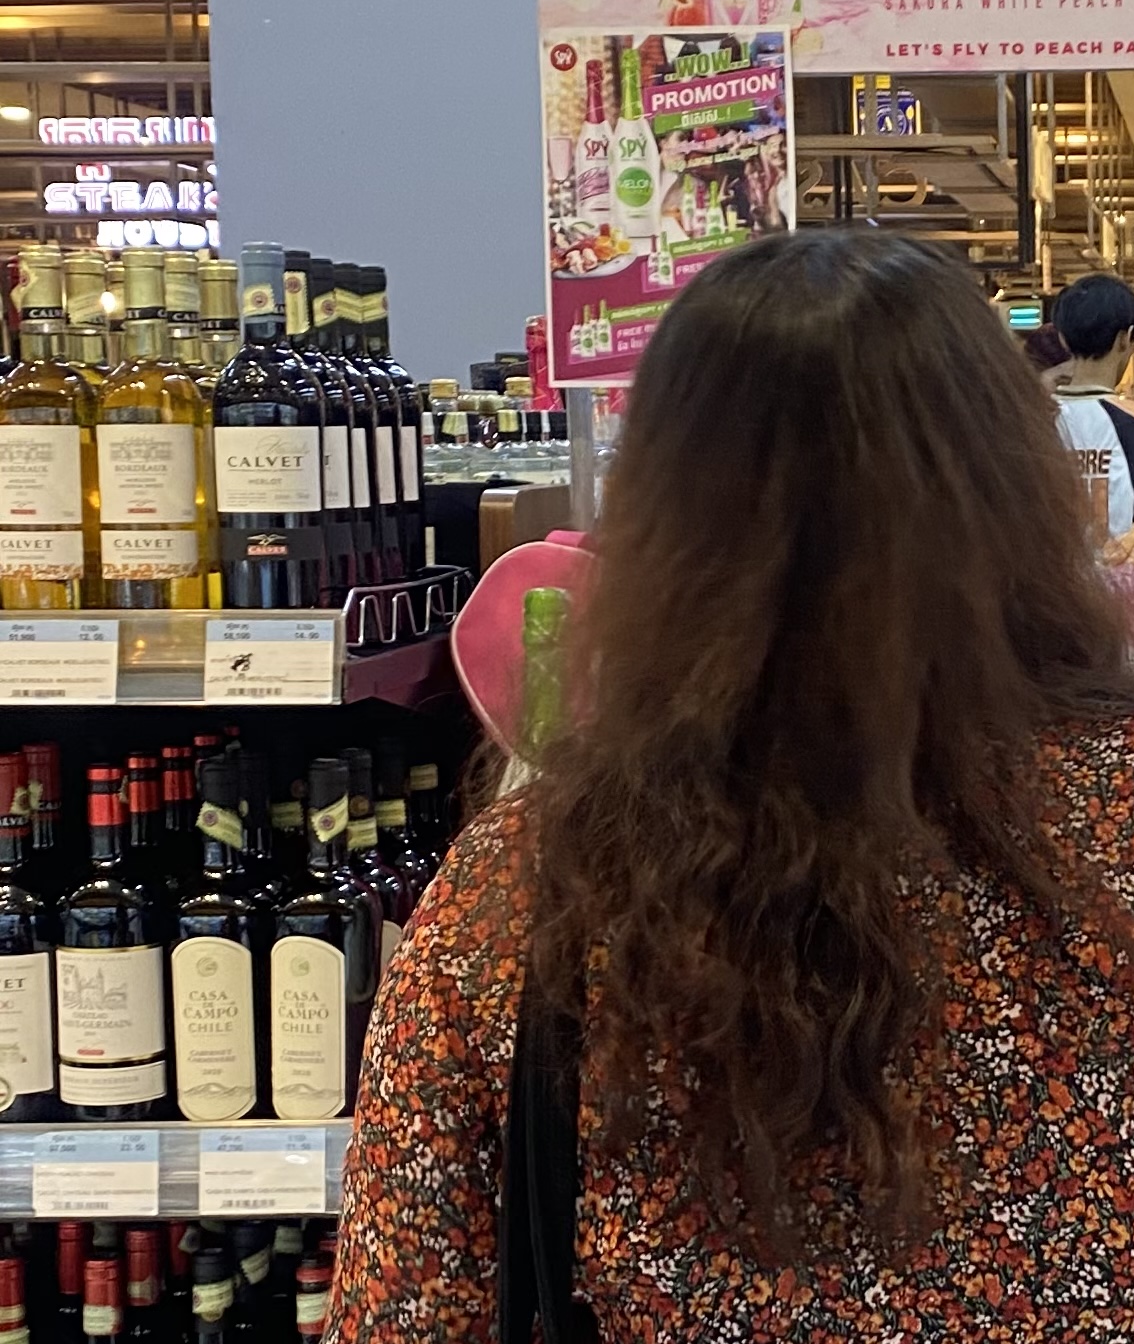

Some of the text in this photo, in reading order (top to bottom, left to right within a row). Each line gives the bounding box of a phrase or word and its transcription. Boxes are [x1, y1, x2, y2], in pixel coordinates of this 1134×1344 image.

[886, 42, 945, 56] LET'S
[952, 42, 992, 56] FLY
[999, 42, 1025, 55] TO
[1035, 40, 1103, 54] PEACH
[651, 72, 777, 111] PROMOTION
[584, 134, 610, 157] SPY
[619, 133, 648, 157] SPY
[227, 455, 305, 468] CALVET
[113, 538, 174, 549] CALVET
[188, 990, 228, 1001] CASA
[283, 990, 319, 1002] CASA
[183, 1006, 238, 1019] CAMPO
[278, 1006, 329, 1019] CAMPO
[188, 1022, 233, 1033] CHILE
[281, 1022, 323, 1034] CHILE
